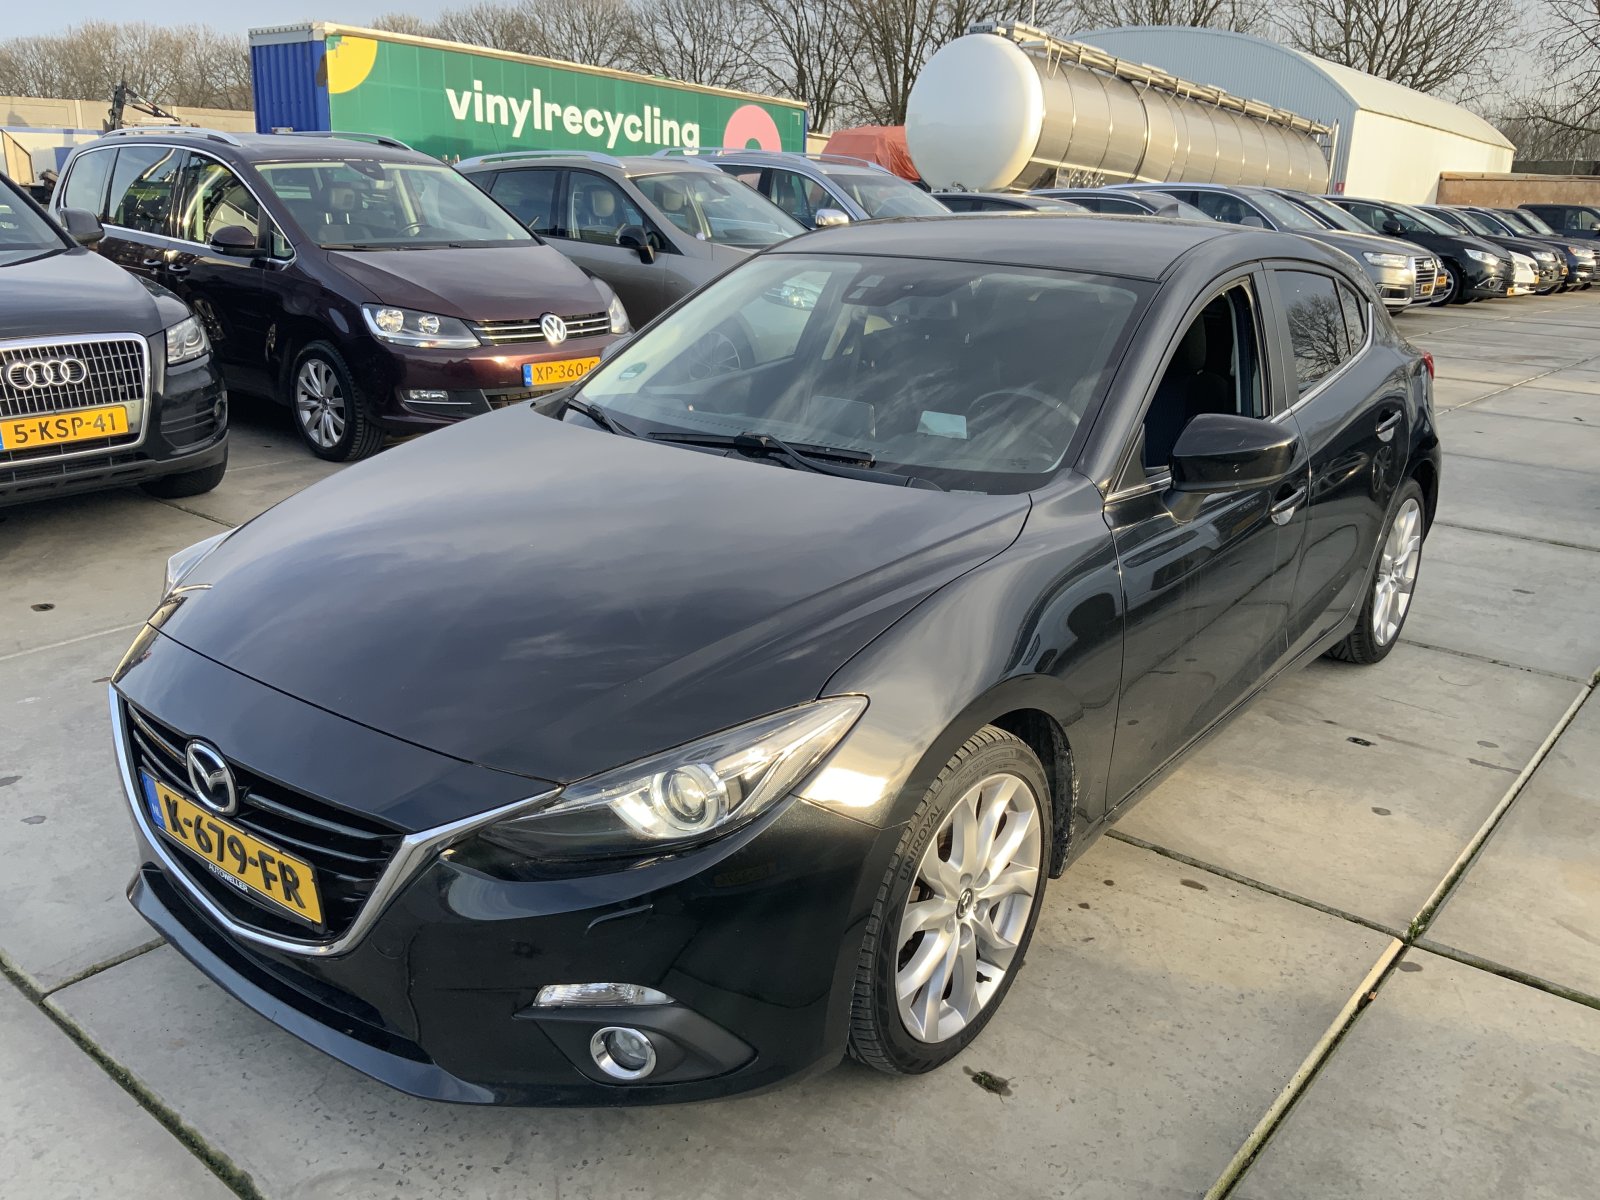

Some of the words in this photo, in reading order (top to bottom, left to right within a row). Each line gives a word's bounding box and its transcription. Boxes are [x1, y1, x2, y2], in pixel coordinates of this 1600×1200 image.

[446, 79, 700, 156] vinylrecycling
[14, 412, 116, 444] 5-KSP-41
[151, 802, 163, 819] NL
[901, 805, 944, 881] UNIROYAL
[163, 794, 307, 909] K-679-FR
